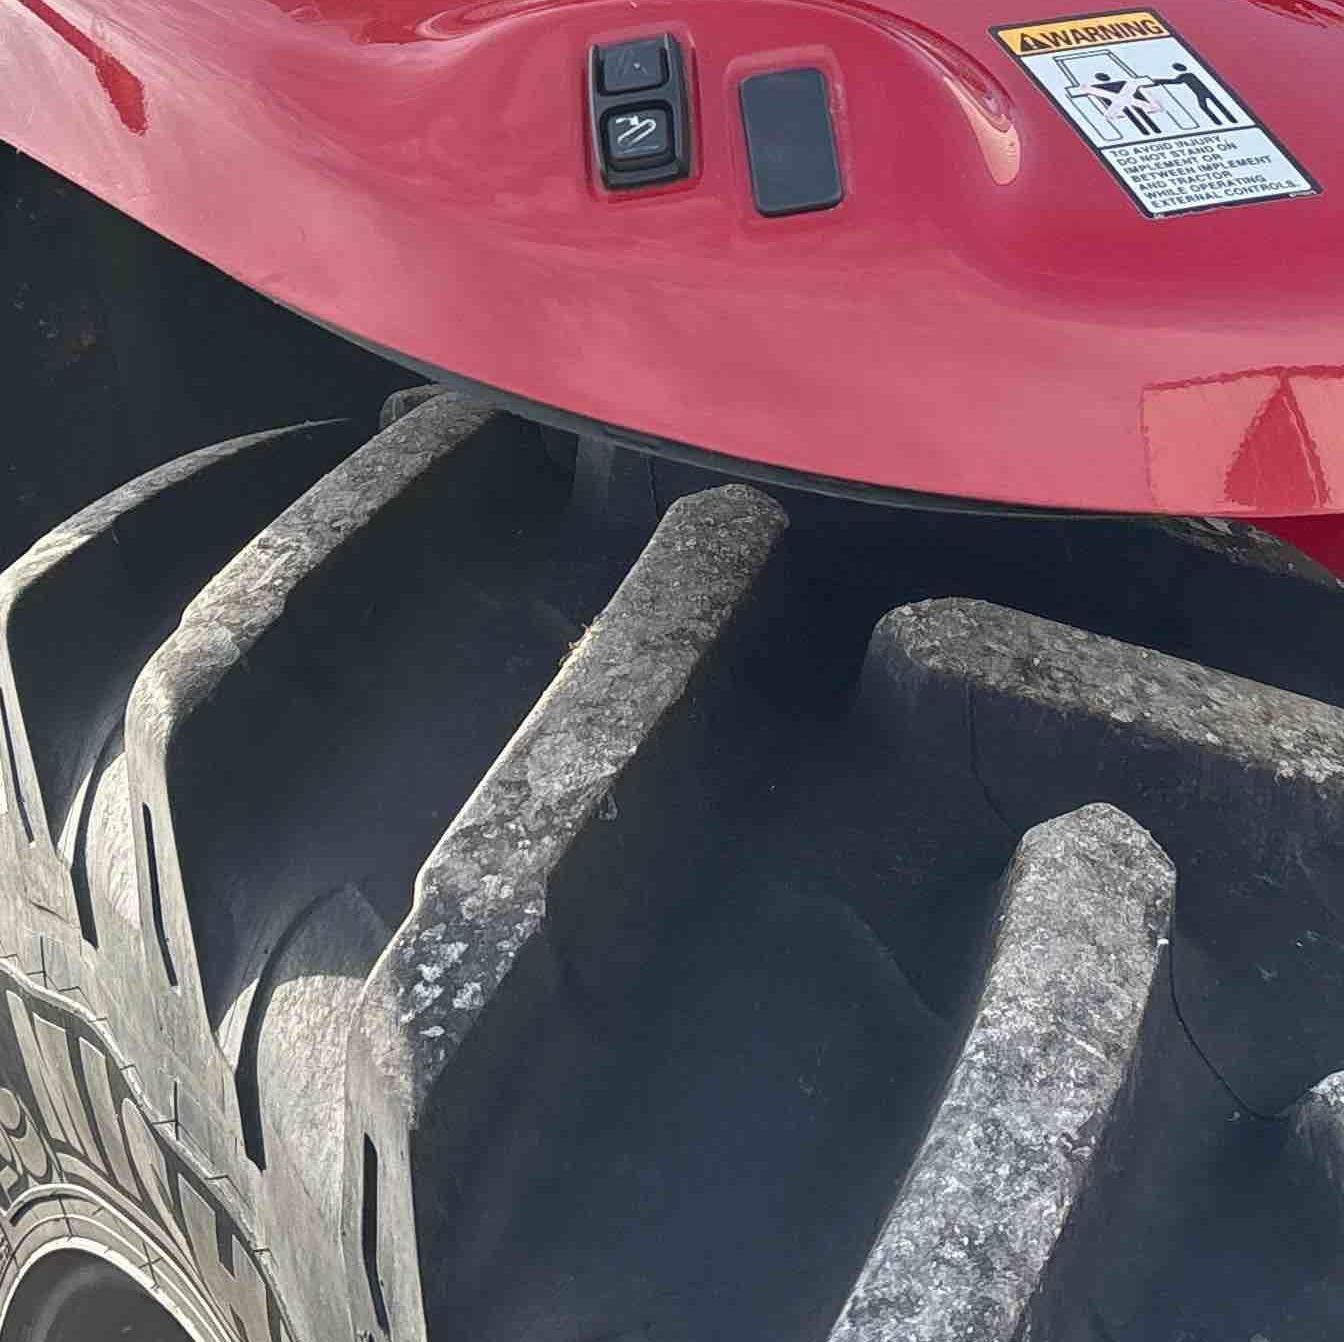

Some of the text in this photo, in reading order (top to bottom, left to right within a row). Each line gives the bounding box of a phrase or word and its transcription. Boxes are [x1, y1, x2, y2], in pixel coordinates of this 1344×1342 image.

[1040, 19, 1164, 47] WARNING
[1109, 148, 1130, 157] TO
[1132, 142, 1173, 154] AVOID
[1116, 142, 1238, 166] DO NOT STAND ON
[1123, 153, 1223, 174] IMPLEMENT OR
[1130, 154, 1272, 183] BETWEEN IMPLEMENT
[1139, 170, 1233, 191] AND TRACTOR
[1144, 174, 1267, 200] WHILE OPERATING
[1151, 192, 1224, 208] EXTERNAL
